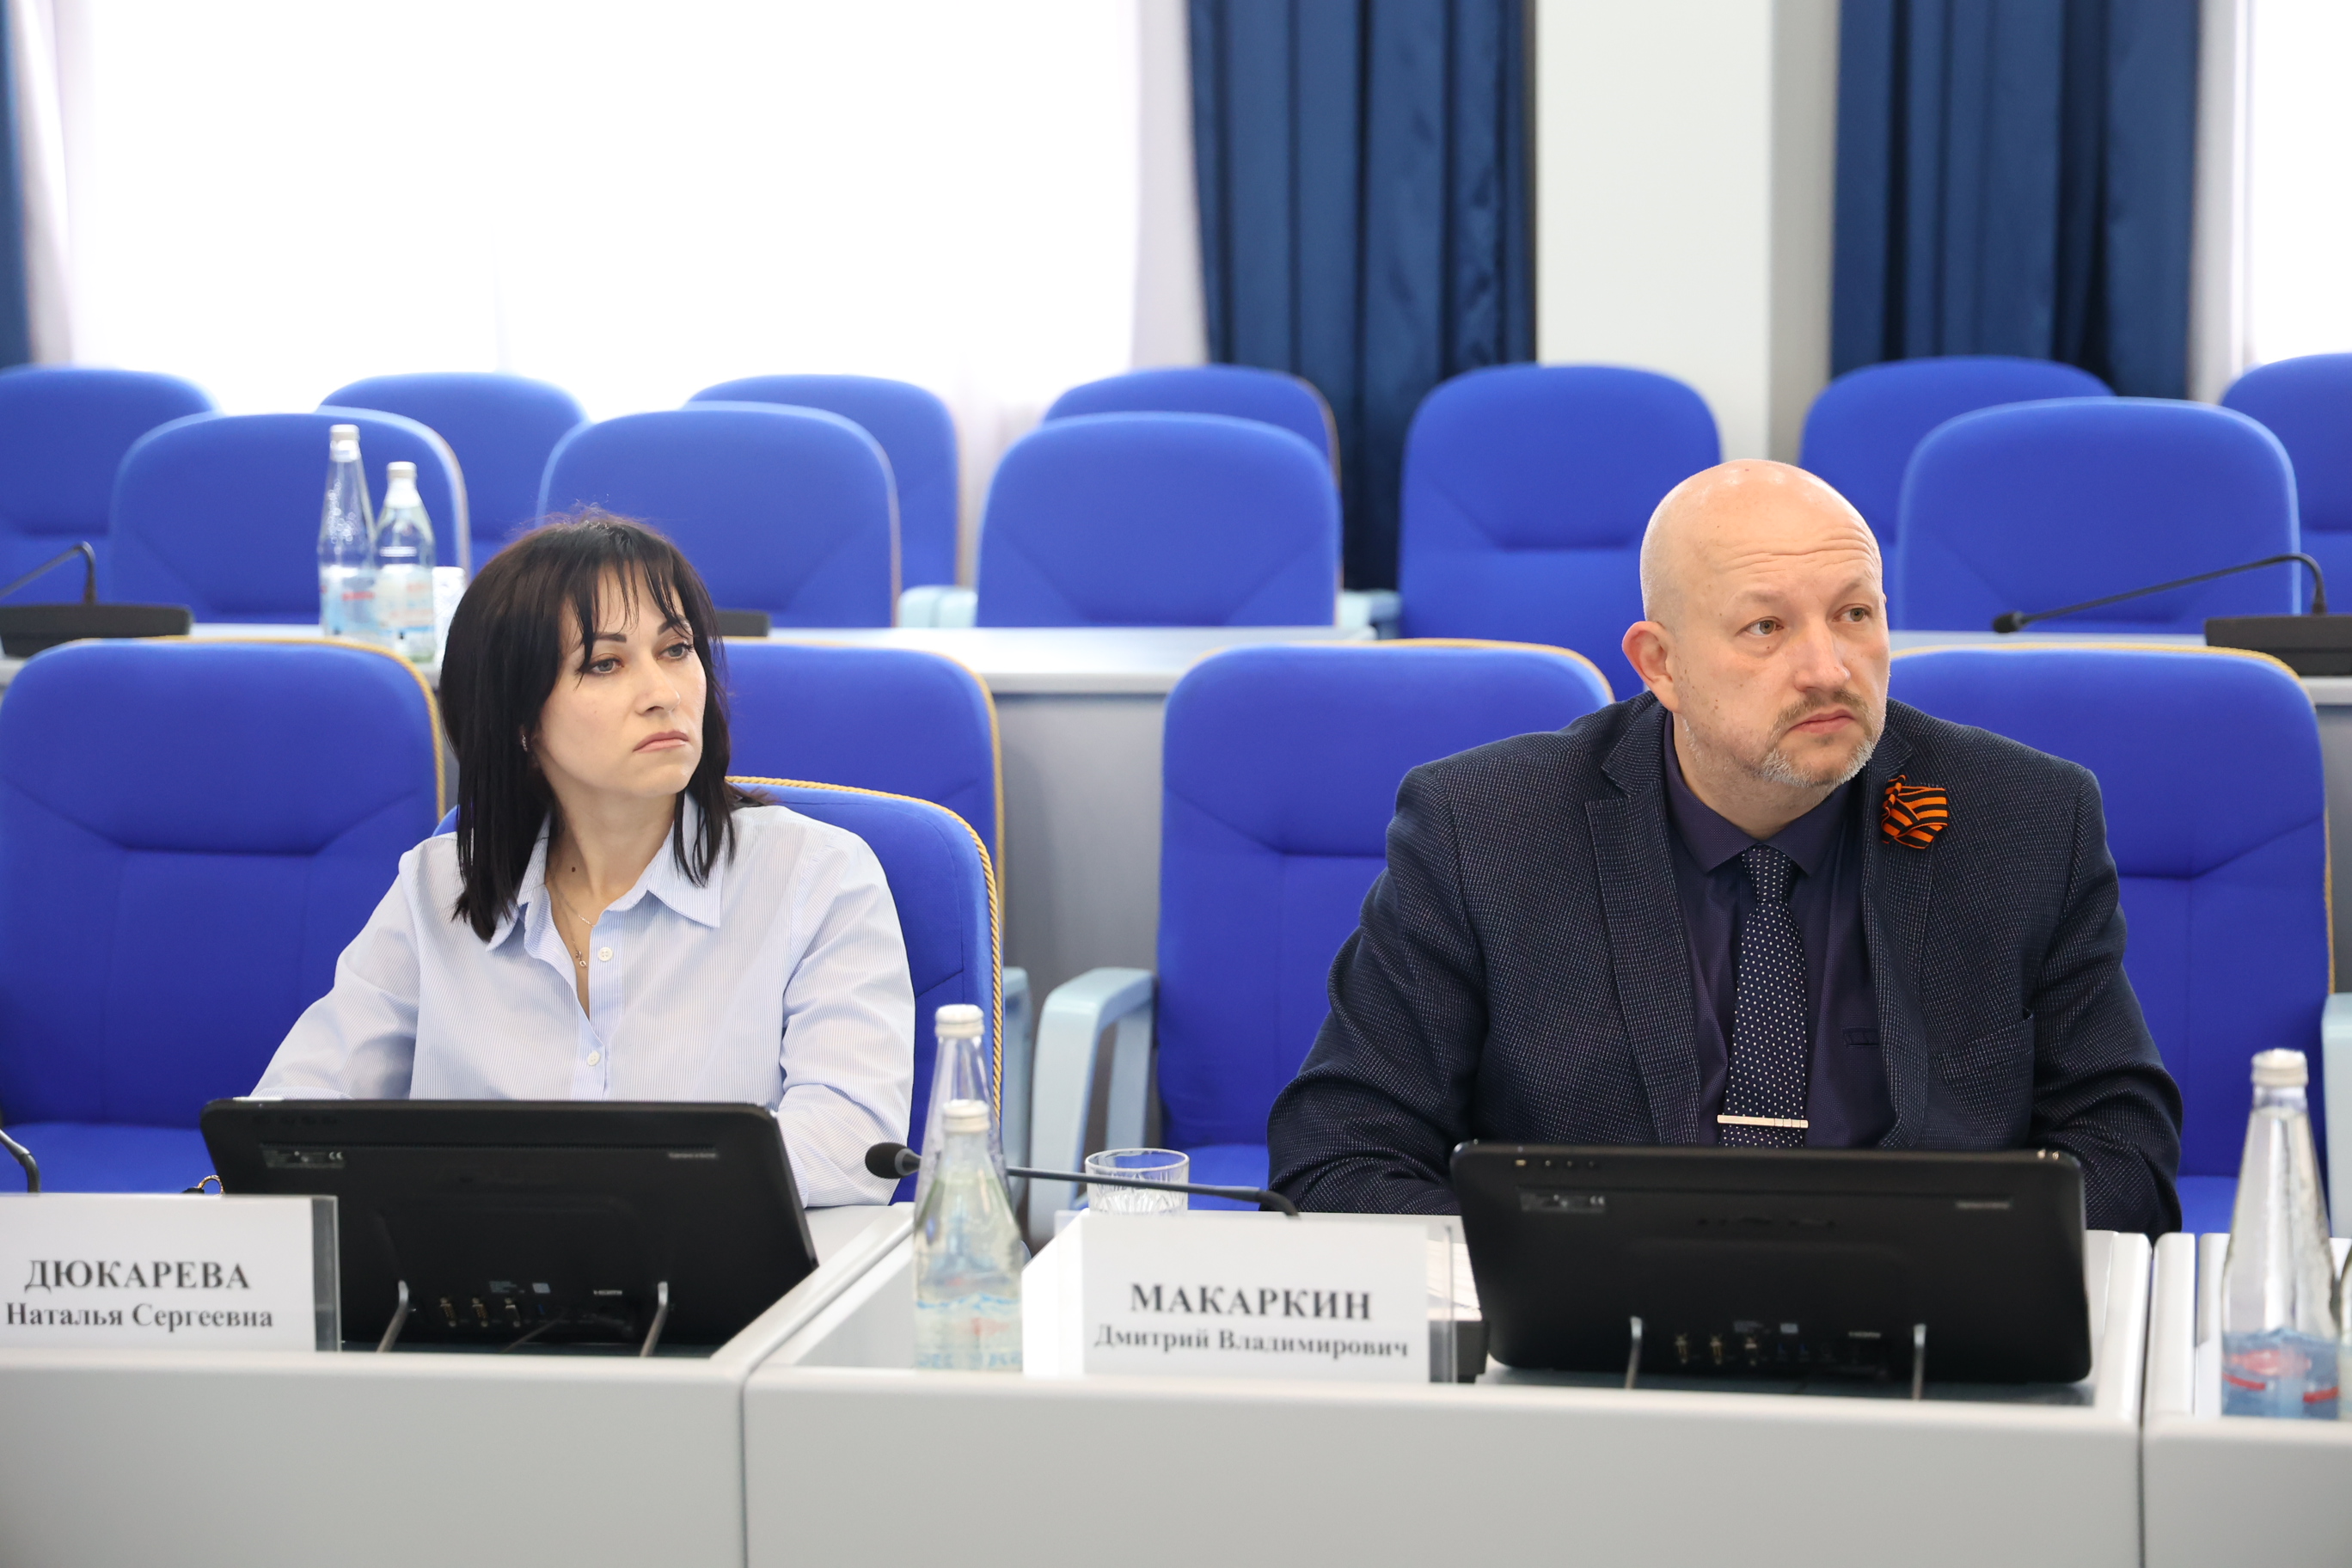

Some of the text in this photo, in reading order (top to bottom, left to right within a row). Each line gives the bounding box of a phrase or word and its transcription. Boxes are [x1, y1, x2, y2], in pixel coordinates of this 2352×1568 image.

[24, 1259, 250, 1293] ДЮКАРЕВА
[5, 1302, 273, 1332] Наталья Сергеевна
[1130, 1283, 1372, 1320] МАКАРКИН
[1094, 1324, 1409, 1359] Дмитрий Владимирович
